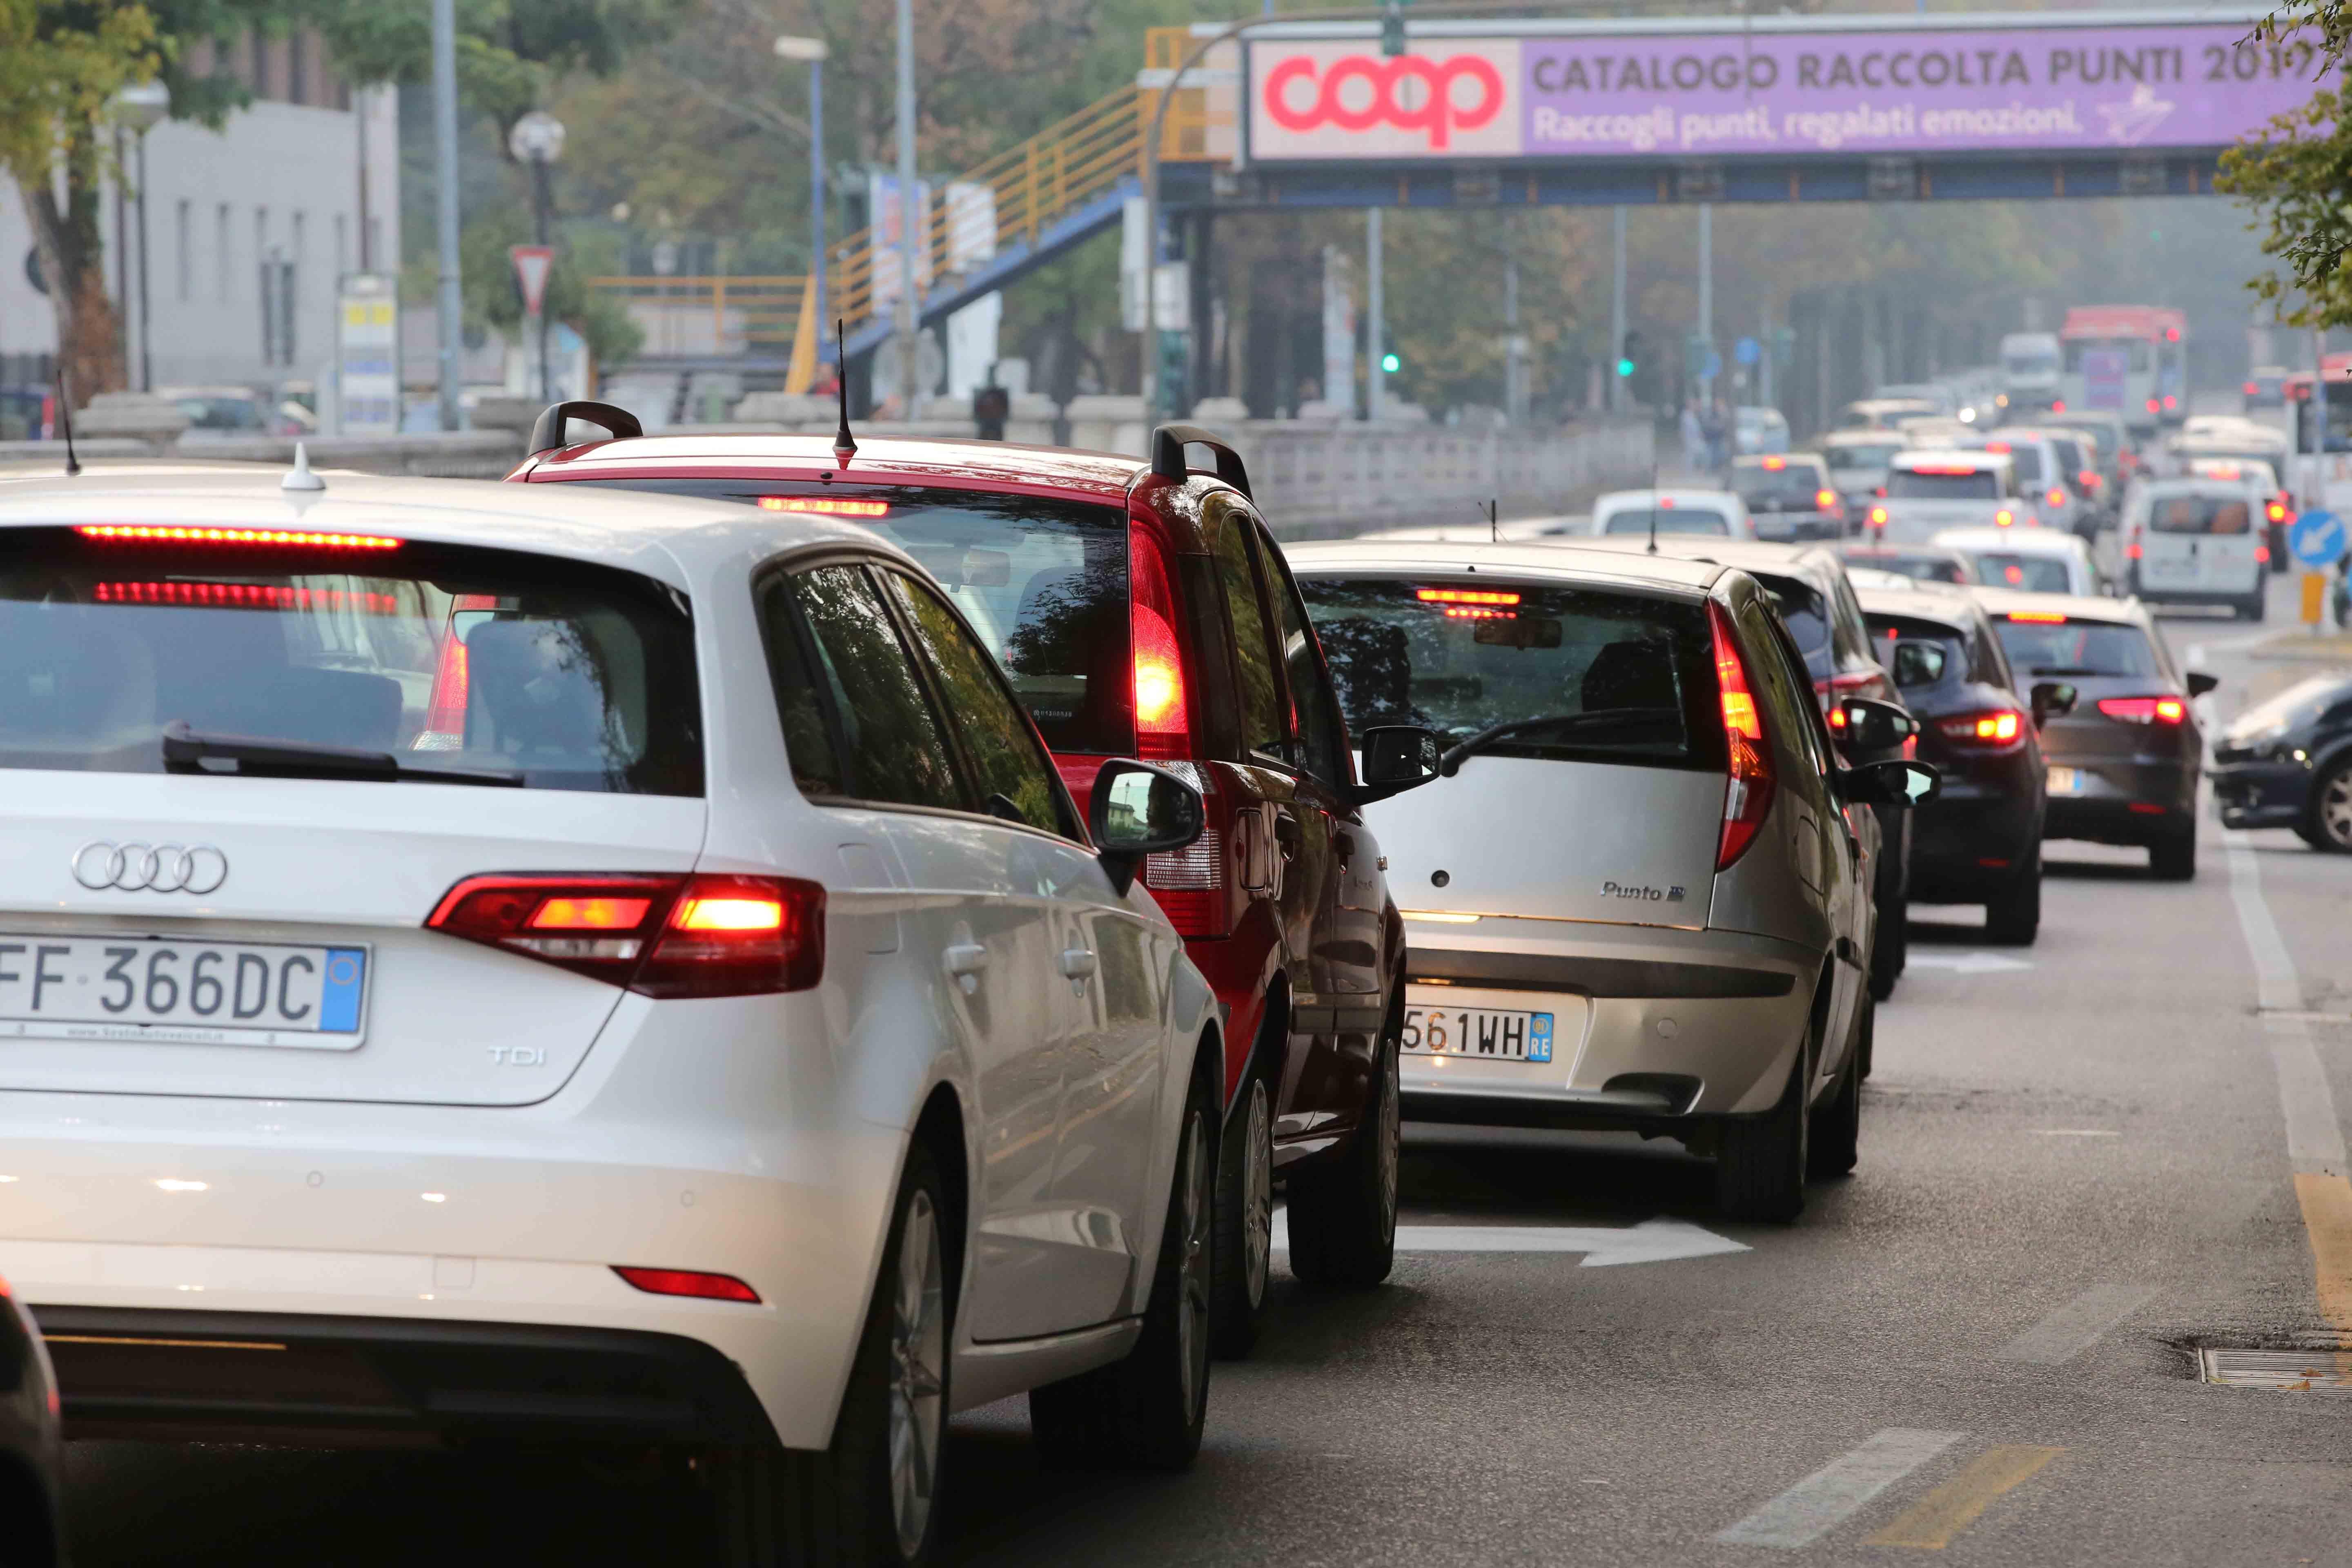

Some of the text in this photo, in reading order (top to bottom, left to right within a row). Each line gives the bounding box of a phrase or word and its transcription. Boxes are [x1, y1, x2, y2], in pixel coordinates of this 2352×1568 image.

[1533, 55, 1779, 92] CATALOGO
[1797, 49, 2031, 88] RACCOLTA
[2049, 47, 2183, 83] PUNTI
[1263, 54, 1507, 151] coop
[1532, 105, 1674, 151] Raccogli
[1679, 104, 1778, 151] punti,
[1784, 102, 1915, 149] regalati
[1601, 881, 1662, 900] Punto
[99, 947, 314, 1021] 366DC
[487, 1045, 548, 1067] TDI
[1531, 1038, 1549, 1056] RE
